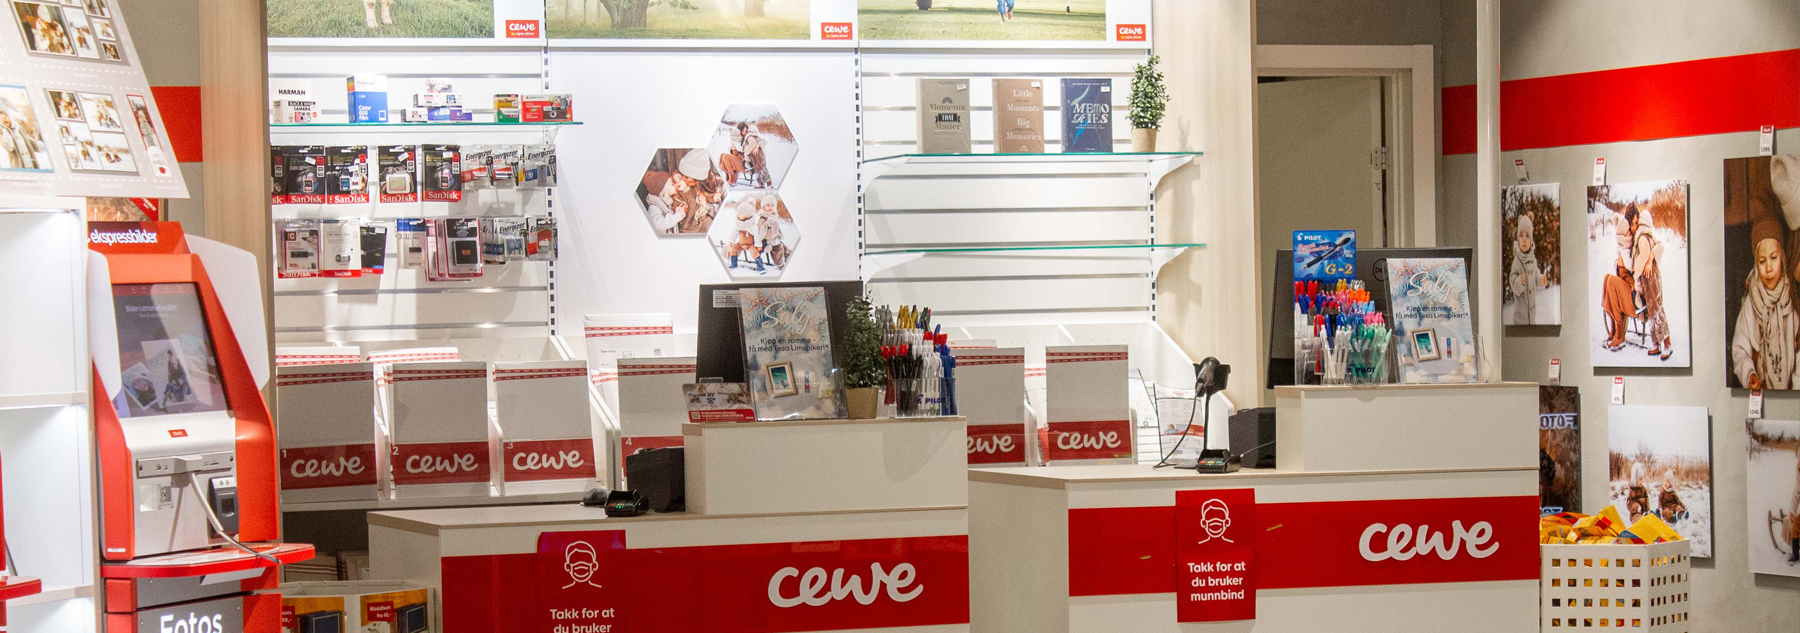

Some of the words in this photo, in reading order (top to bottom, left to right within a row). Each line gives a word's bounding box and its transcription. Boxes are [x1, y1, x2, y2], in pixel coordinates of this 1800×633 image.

[509, 23, 536, 31] cewe
[824, 25, 849, 33] cewe
[1119, 27, 1143, 35] cewe
[1013, 89, 1033, 97] Little
[1006, 103, 1040, 111] Moments
[935, 122, 962, 130] Matter
[1017, 117, 1031, 128] Big
[1006, 131, 1042, 140] Memories
[465, 150, 492, 160] Energizer
[528, 148, 555, 160] Energizer
[291, 195, 323, 203] SanDisk
[334, 195, 367, 203] SanDisk
[381, 194, 414, 203] SanDisk
[428, 191, 459, 200] SanDisk
[500, 221, 525, 234] Energizer
[90, 229, 157, 246] ekspressbilder
[1407, 271, 1452, 303] Salg
[1406, 305, 1420, 313] Kjøp
[761, 299, 811, 335] Salg
[507, 441, 514, 450] 3
[625, 437, 632, 446] 4
[967, 435, 1015, 454] ewe
[1057, 430, 1121, 450] cewe
[282, 449, 287, 458] 1
[392, 446, 399, 455] 2
[405, 453, 479, 474] cewe
[512, 450, 584, 471] cewe
[290, 456, 365, 478] cewe
[1359, 520, 1500, 562] cewe
[1188, 562, 1214, 573] Takk
[1216, 561, 1231, 572] for
[1233, 561, 1246, 571] at
[767, 562, 924, 608] cewe
[1191, 576, 1206, 587] du
[1208, 575, 1243, 587] bruker
[1190, 589, 1244, 601] munnbind
[550, 608, 579, 620] Takk
[581, 607, 600, 618] for
[601, 607, 615, 618] at
[160, 611, 223, 633] Fotos
[553, 623, 570, 633] du
[572, 622, 612, 633] bruker
